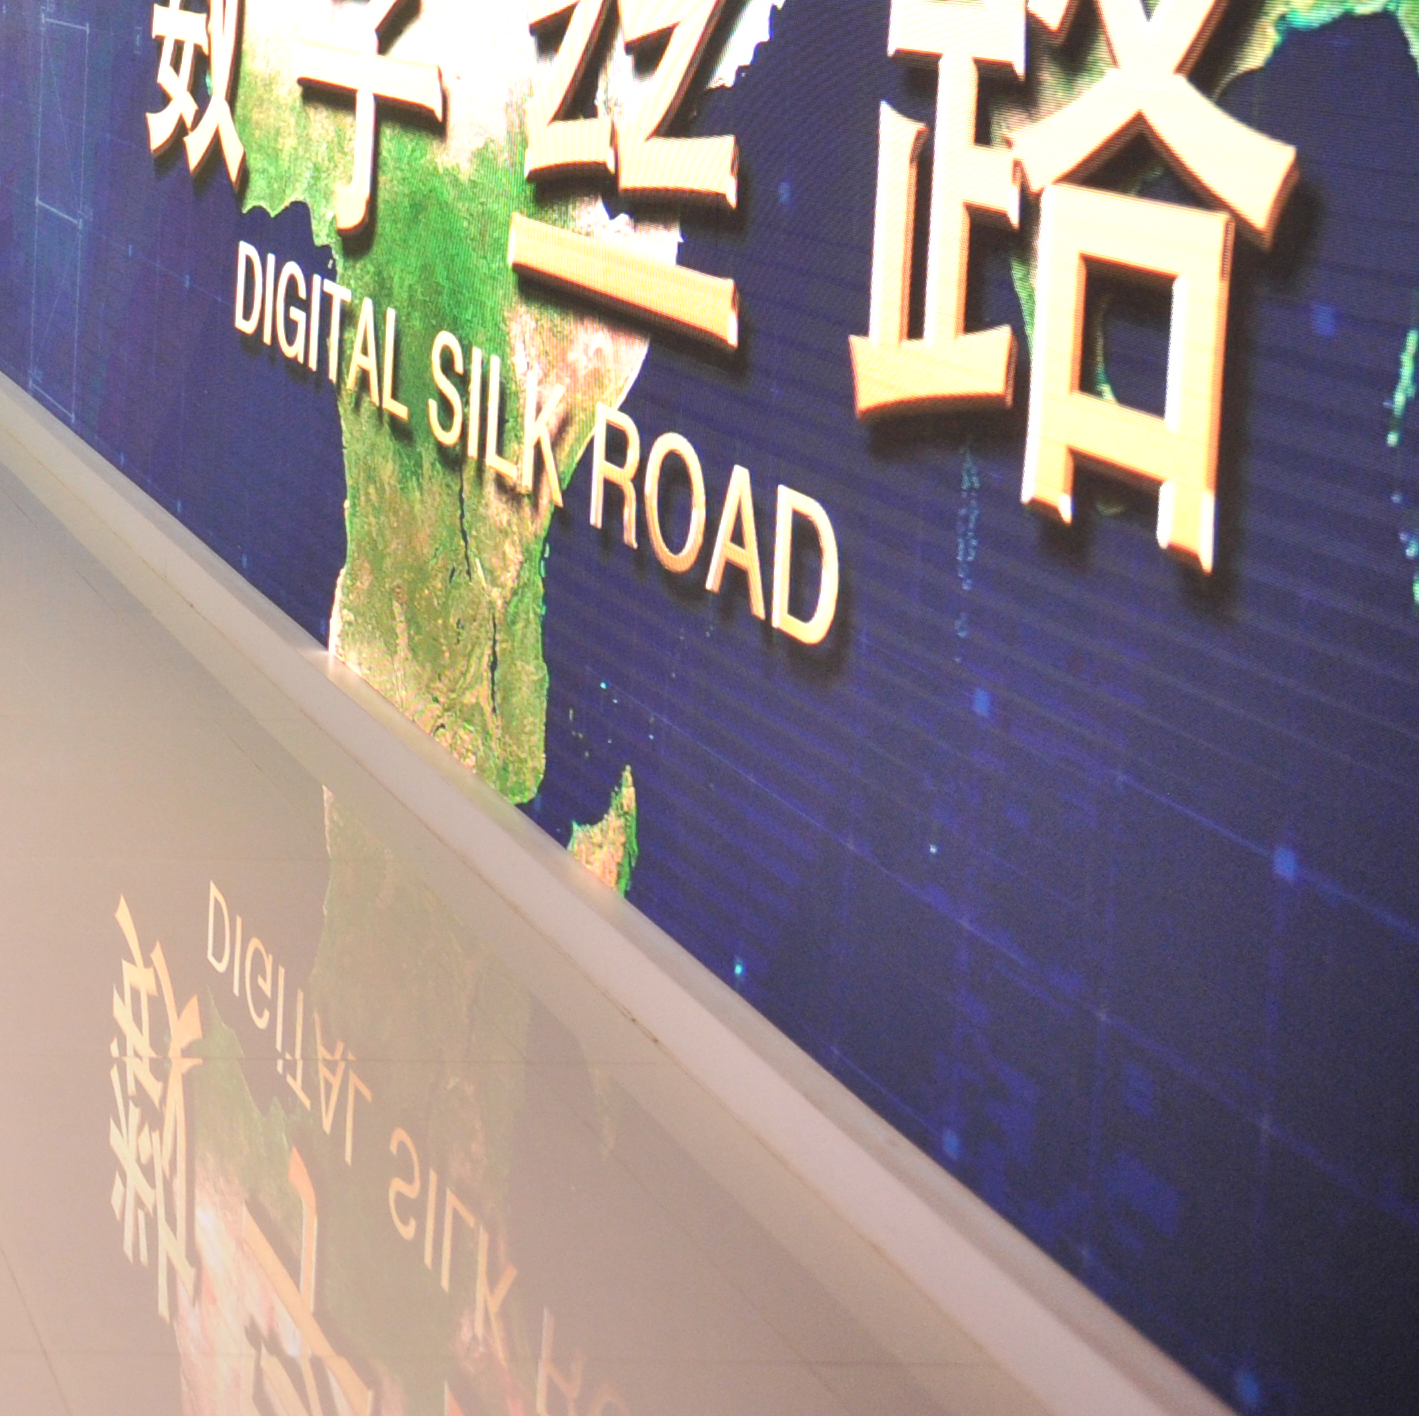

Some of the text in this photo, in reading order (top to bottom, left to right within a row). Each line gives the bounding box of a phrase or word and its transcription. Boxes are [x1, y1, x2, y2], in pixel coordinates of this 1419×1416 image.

[235, 240, 840, 645] DIGITAL SILK ROAD
